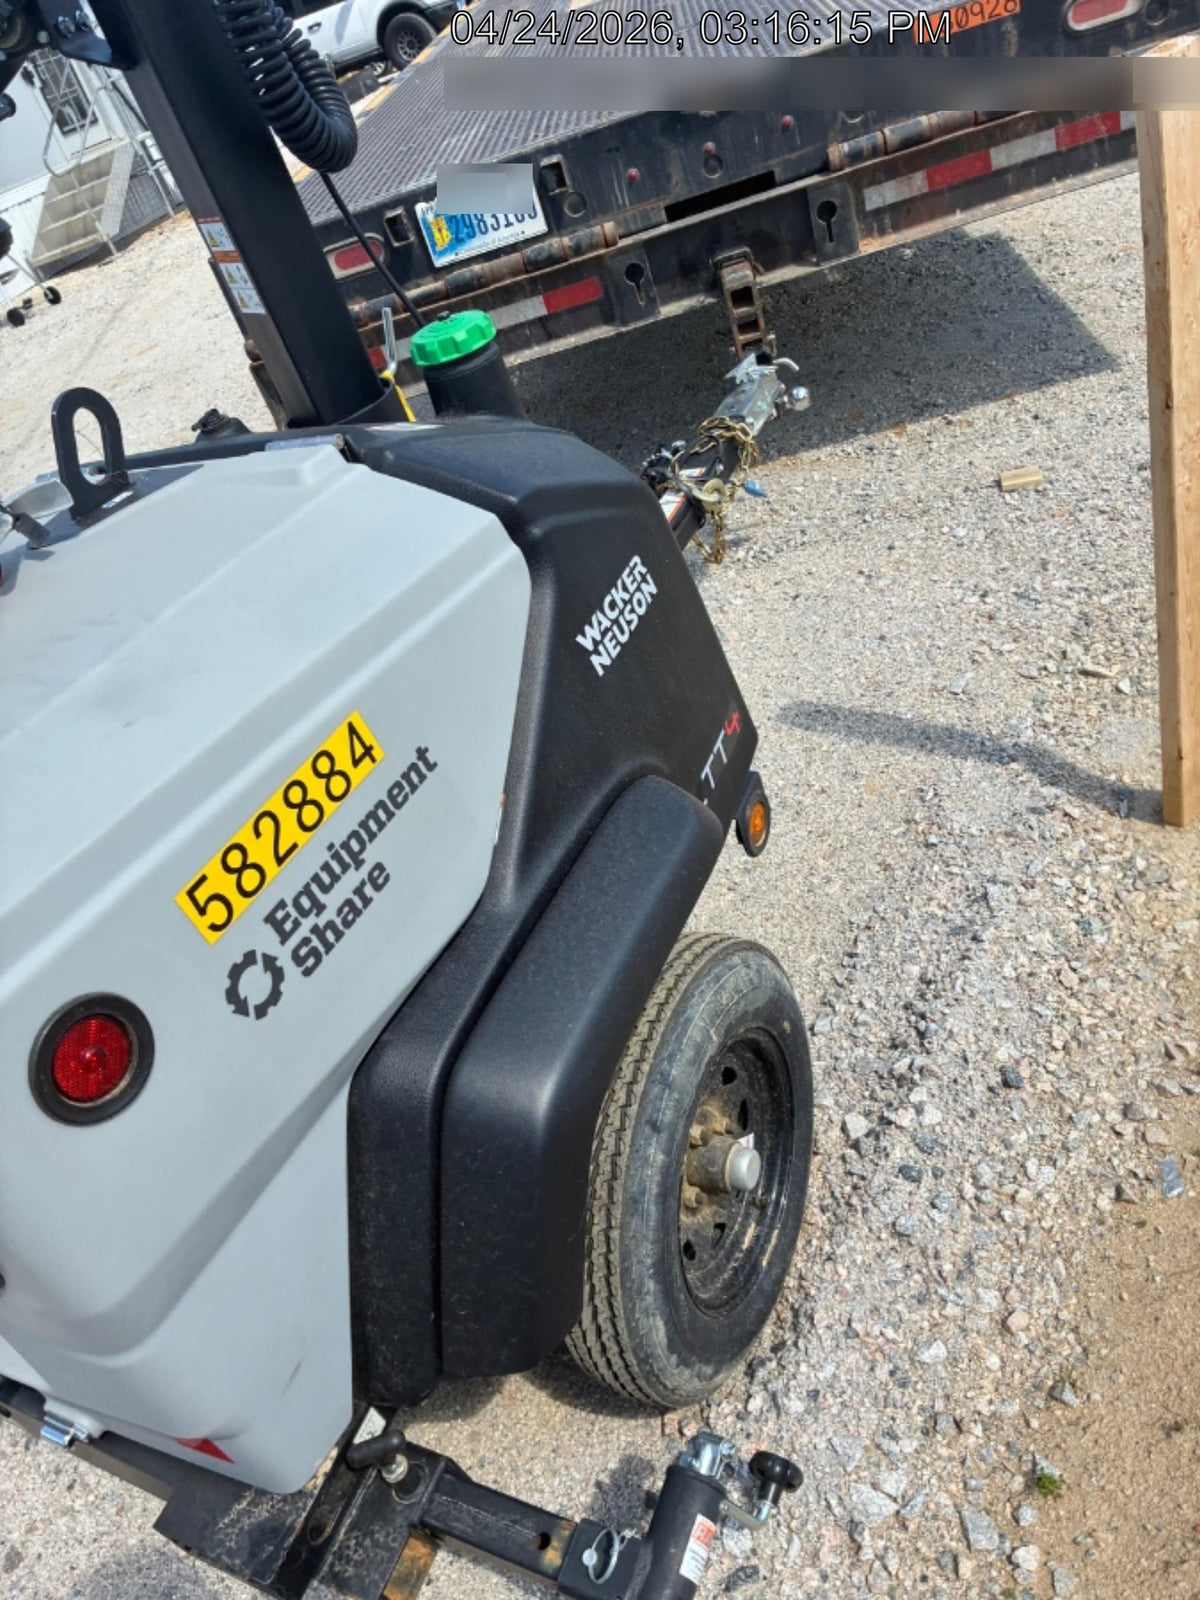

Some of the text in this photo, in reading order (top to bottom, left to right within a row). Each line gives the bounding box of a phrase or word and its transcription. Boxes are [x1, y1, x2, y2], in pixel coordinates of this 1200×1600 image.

[575, 555, 648, 651] WACKER
[589, 572, 658, 677] NEUSON
[700, 711, 741, 806] TT4
[186, 721, 377, 932] 582884
[263, 745, 438, 946] Equipment
[290, 861, 391, 978] Share
